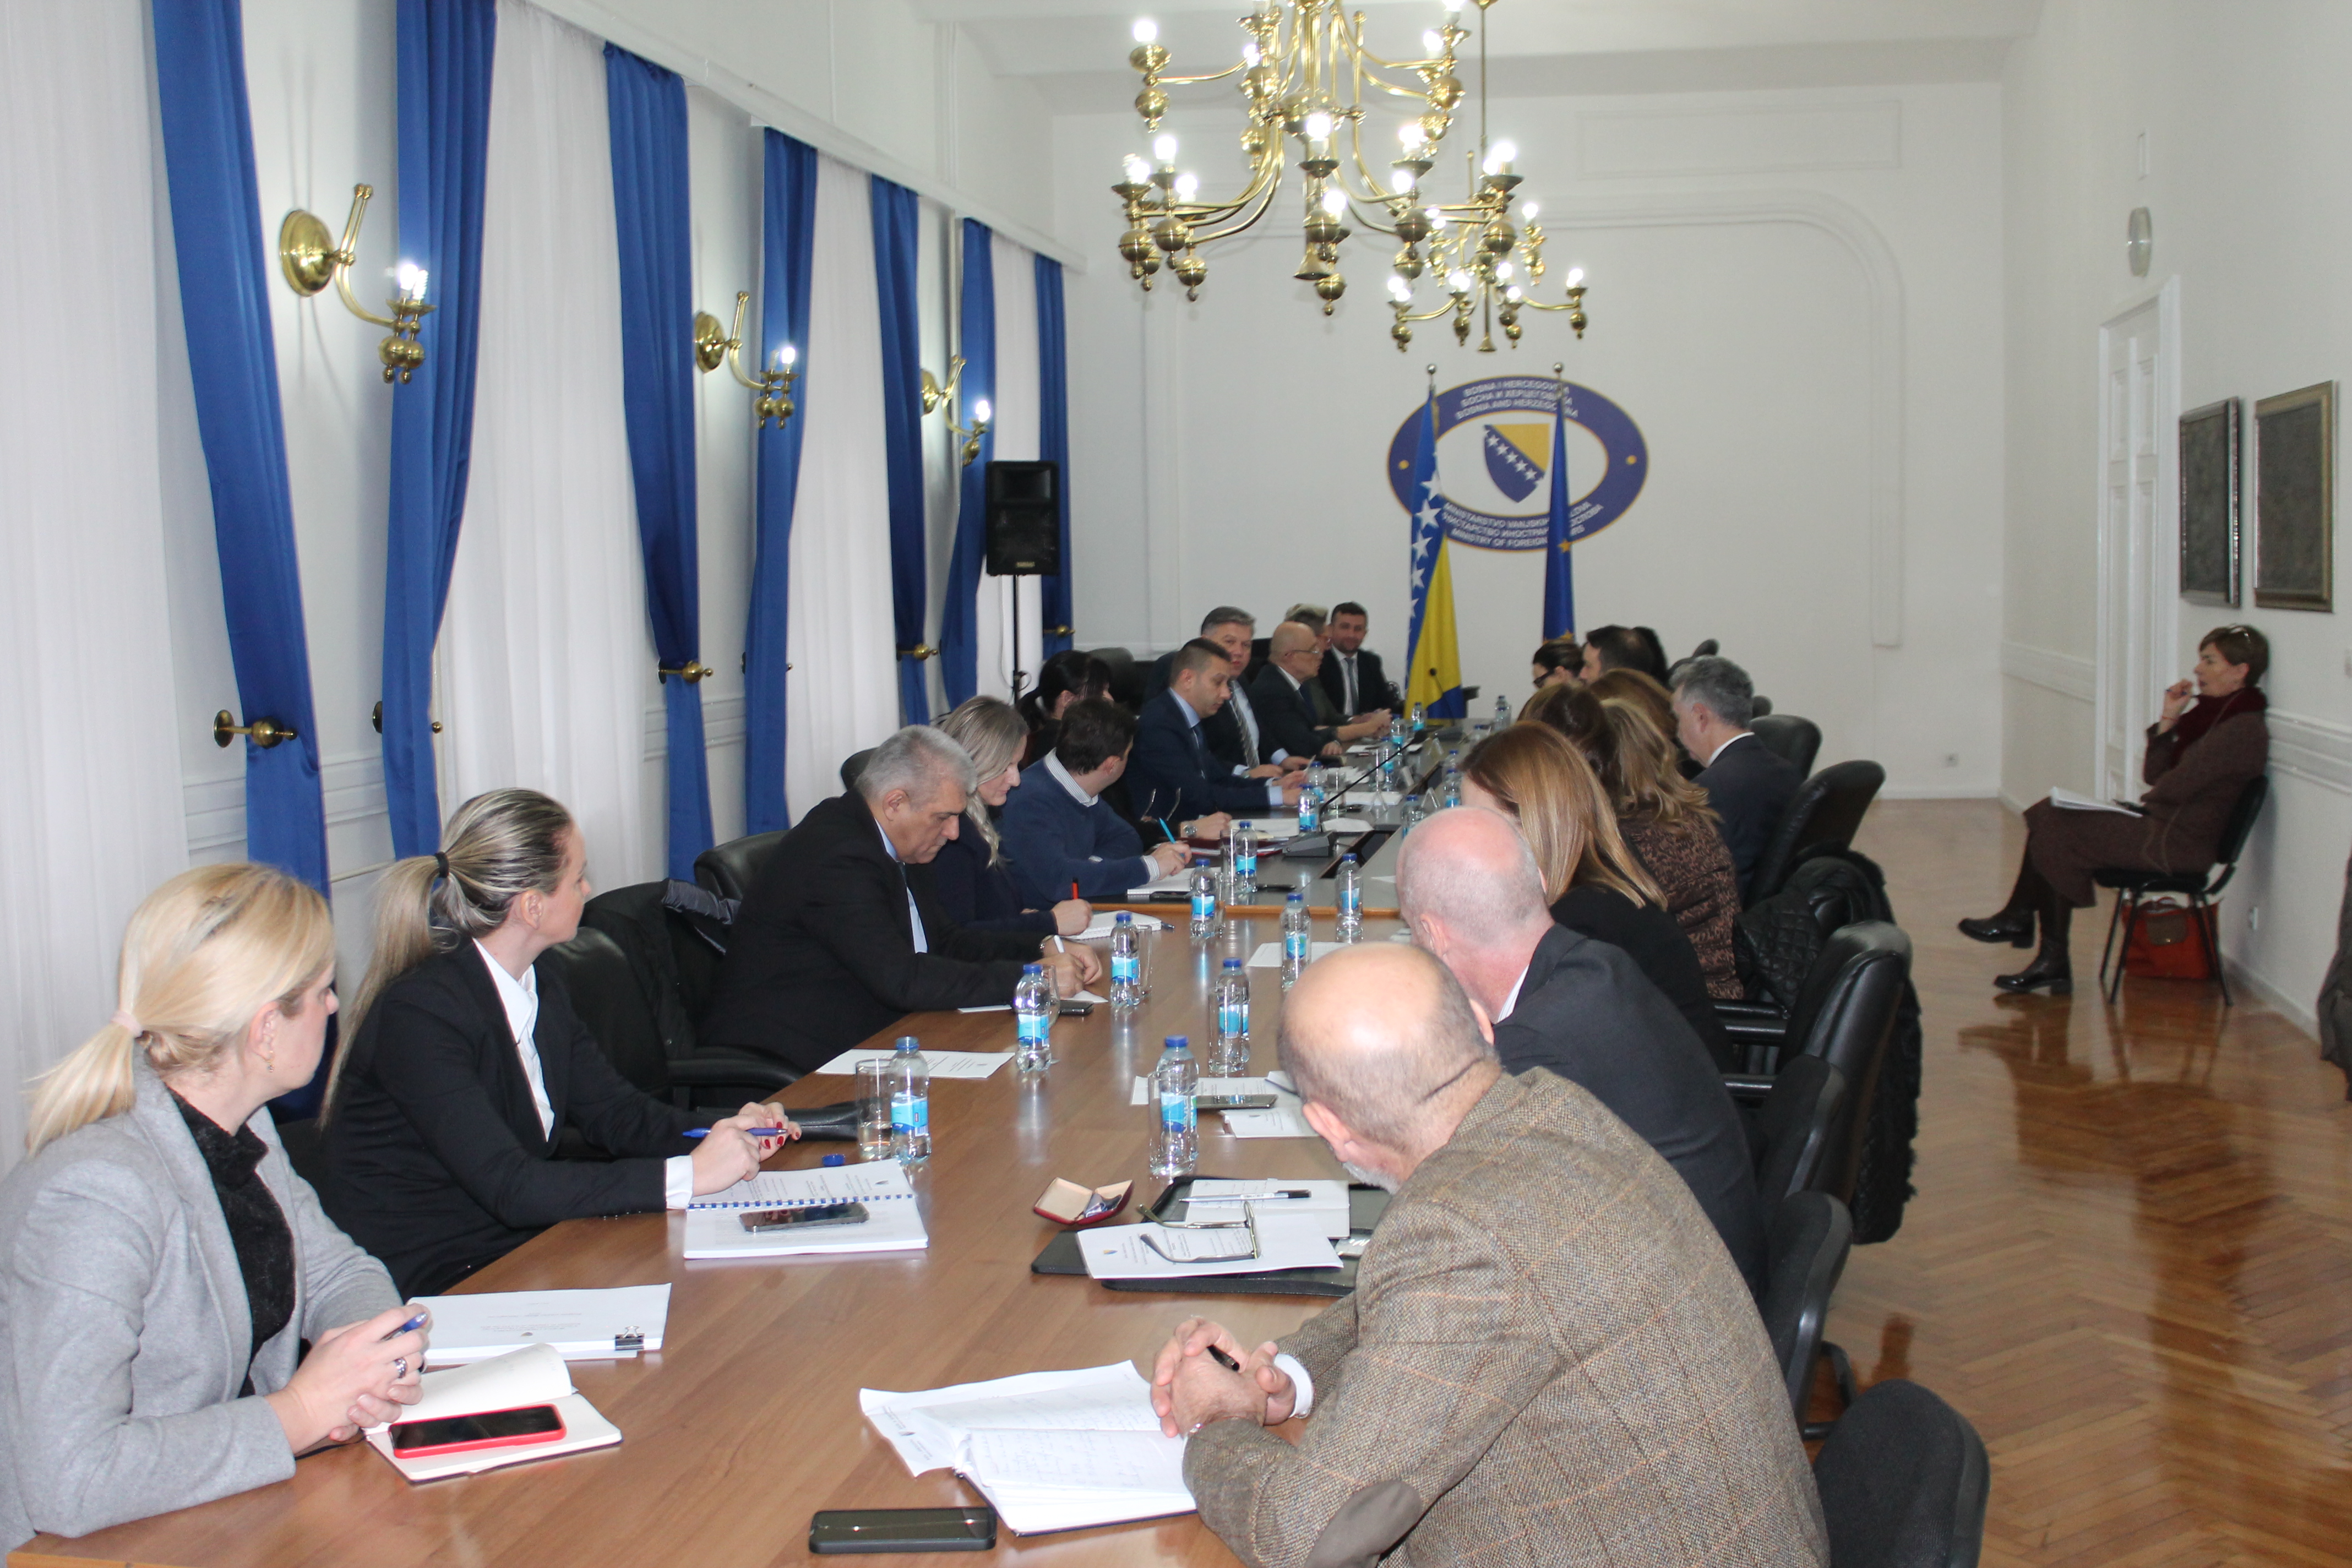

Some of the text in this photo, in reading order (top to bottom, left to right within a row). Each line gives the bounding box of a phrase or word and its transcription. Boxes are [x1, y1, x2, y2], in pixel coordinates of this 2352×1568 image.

[1464, 382, 1496, 396] BOSNA
[1502, 380, 1569, 394] HERCEGOVIA
[1455, 399, 1578, 420] BOSNIA AND HERZEGONA
[1444, 502, 1506, 528] MINISTARSTVO
[1451, 528, 1548, 548] MINISTRY OF FOREIGN
